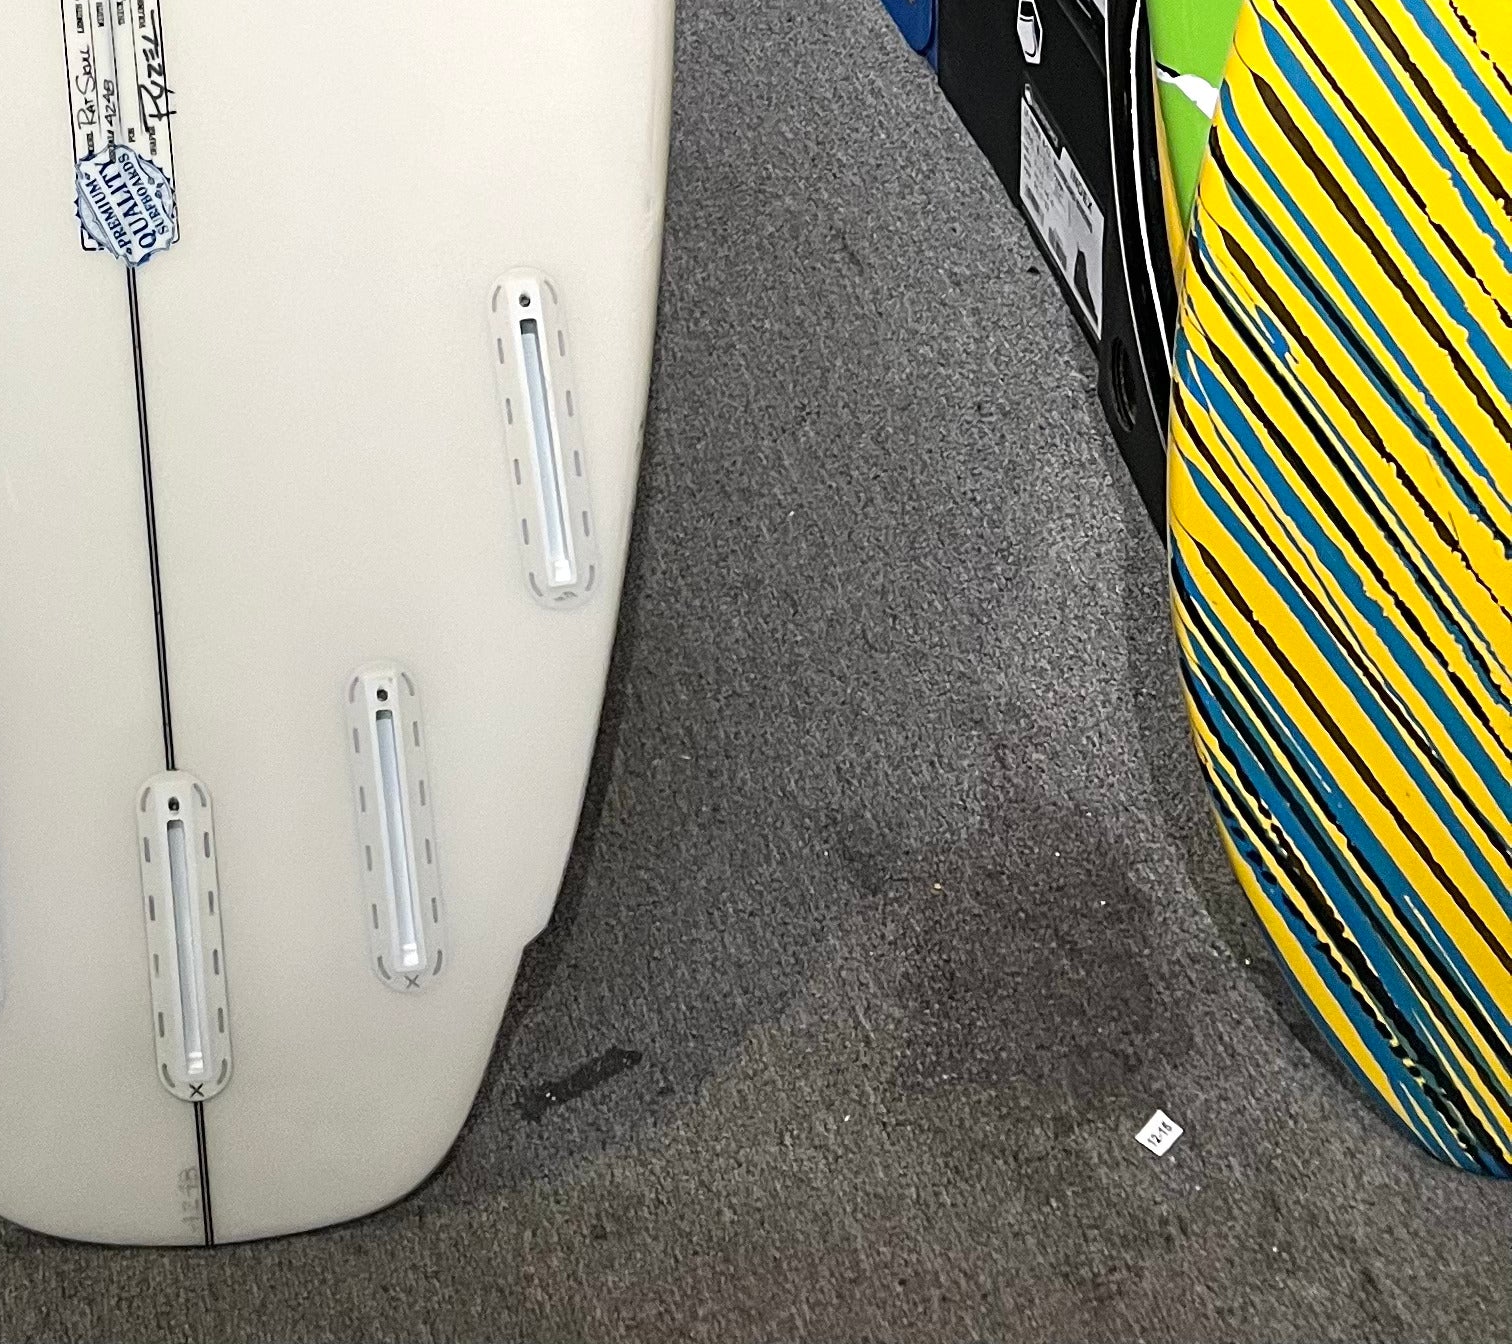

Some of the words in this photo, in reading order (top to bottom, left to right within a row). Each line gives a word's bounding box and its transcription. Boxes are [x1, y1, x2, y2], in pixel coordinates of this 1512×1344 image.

[102, 78, 117, 127] 4248
[84, 178, 132, 249] PREMIUM
[94, 158, 157, 249] QUALITY
[117, 152, 170, 236] SURFBOARDS
